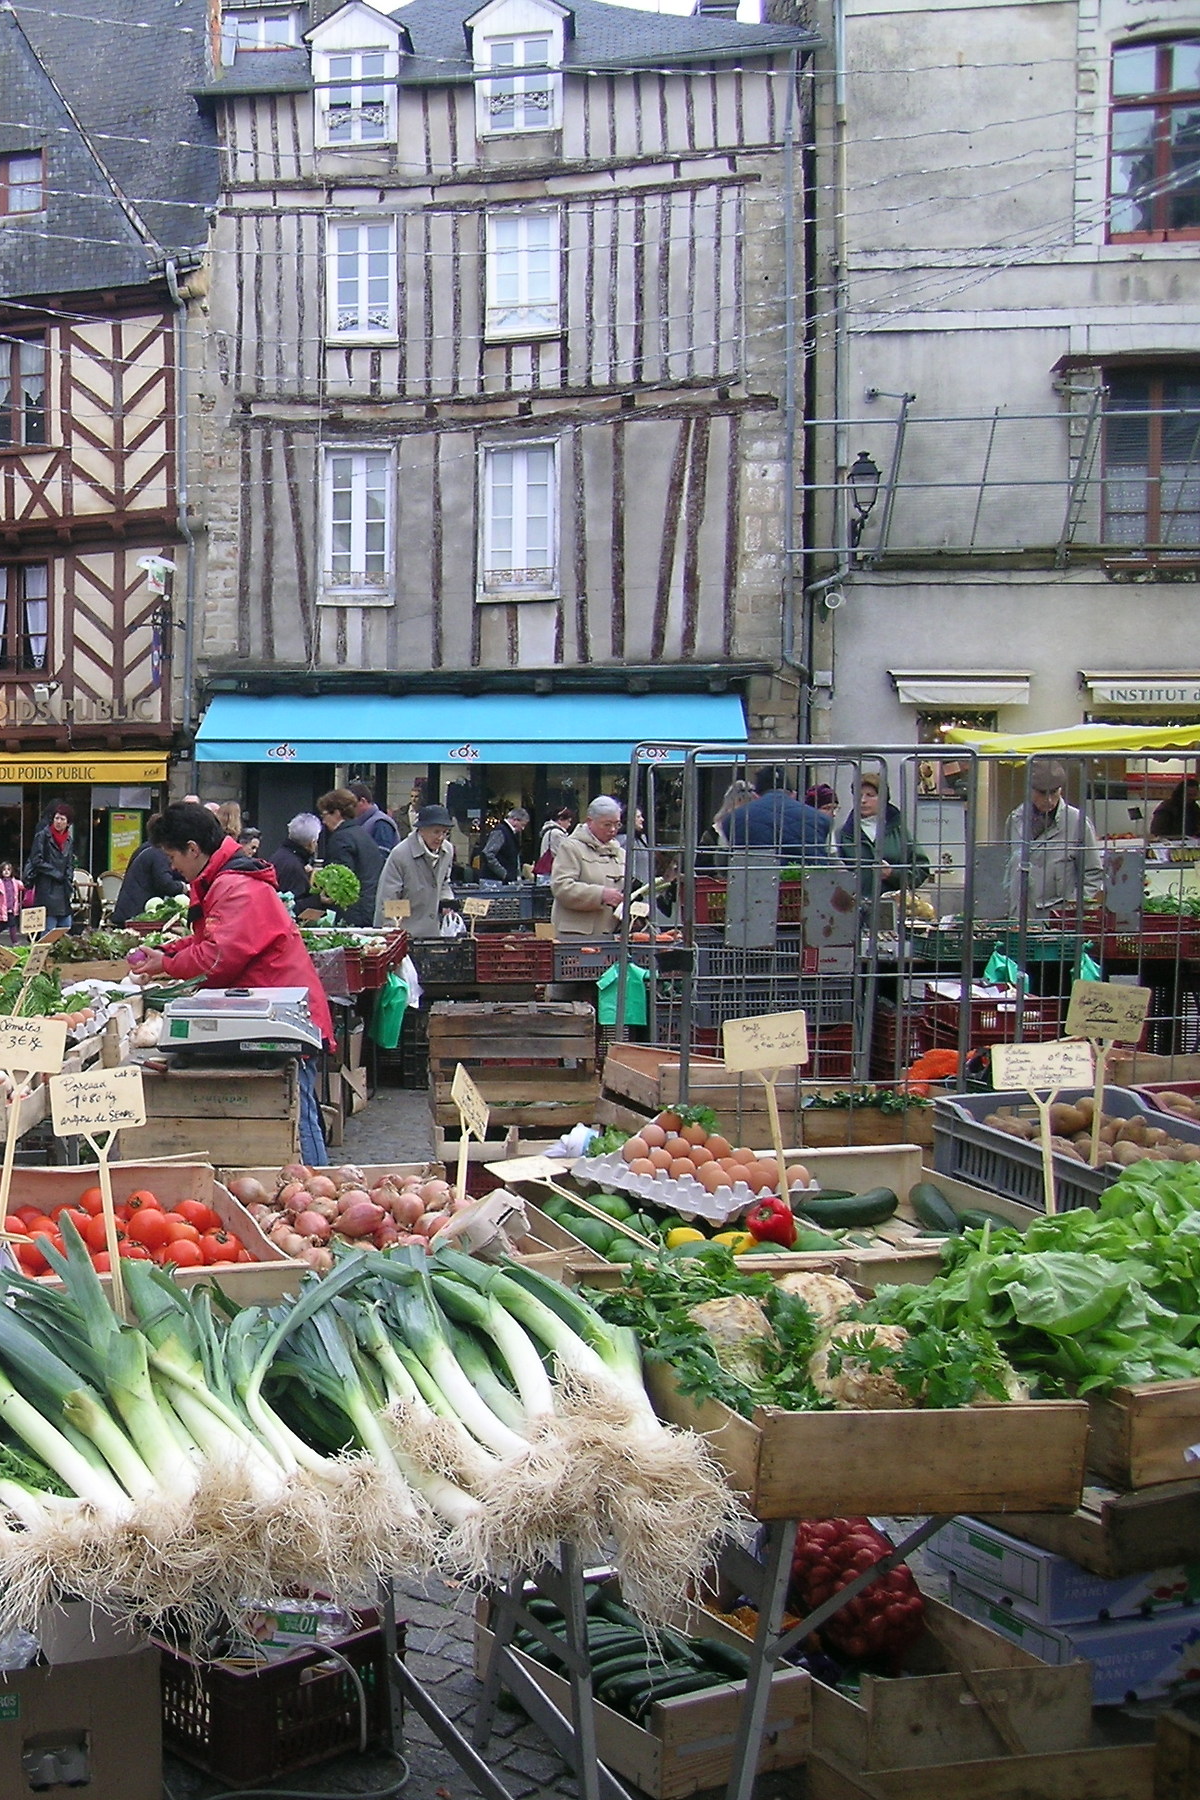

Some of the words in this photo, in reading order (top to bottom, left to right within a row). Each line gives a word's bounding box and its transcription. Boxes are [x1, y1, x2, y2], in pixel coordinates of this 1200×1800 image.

[1110, 689, 1187, 701] INSTITUT
[61, 698, 154, 721] PUBLIC
[18, 767, 53, 779] POIDS
[56, 767, 96, 779] PUBLIC
[1095, 1653, 1138, 1666] NDIVES
[1094, 1669, 1137, 1681] RANCE
